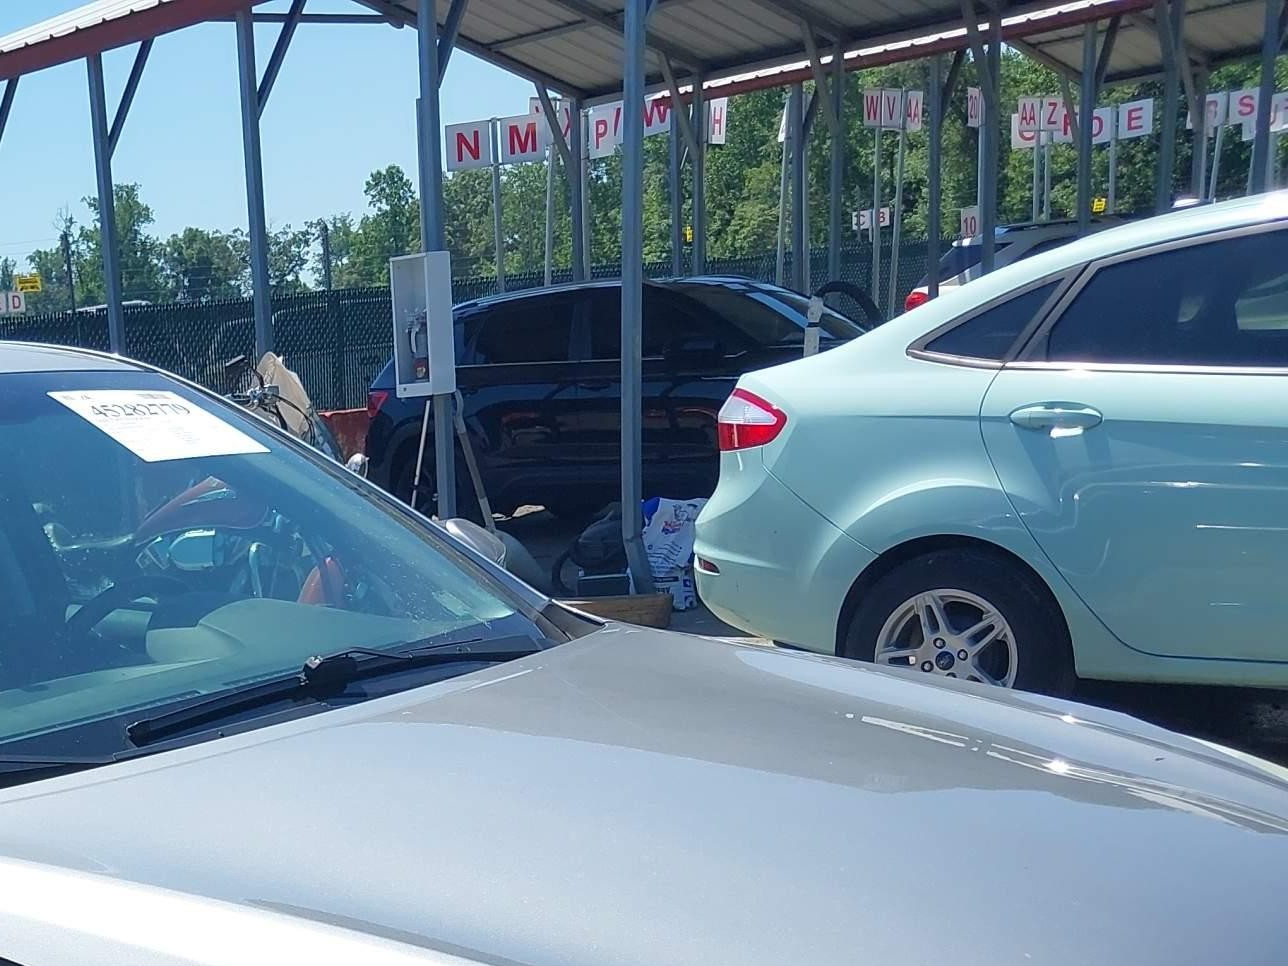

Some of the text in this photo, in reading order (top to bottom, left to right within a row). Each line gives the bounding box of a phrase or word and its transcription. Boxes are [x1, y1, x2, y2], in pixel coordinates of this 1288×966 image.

[865, 95, 879, 120] W
[886, 95, 896, 120] V
[1020, 102, 1036, 126] AA
[1047, 102, 1058, 125] Z
[1238, 94, 1255, 117] S
[712, 106, 723, 136] H
[1127, 107, 1144, 131] E
[455, 129, 480, 162] N
[508, 122, 537, 155] M
[595, 119, 608, 149] P
[963, 215, 977, 235] 10
[12, 295, 21, 309] D
[90, 403, 191, 417] 45282779
